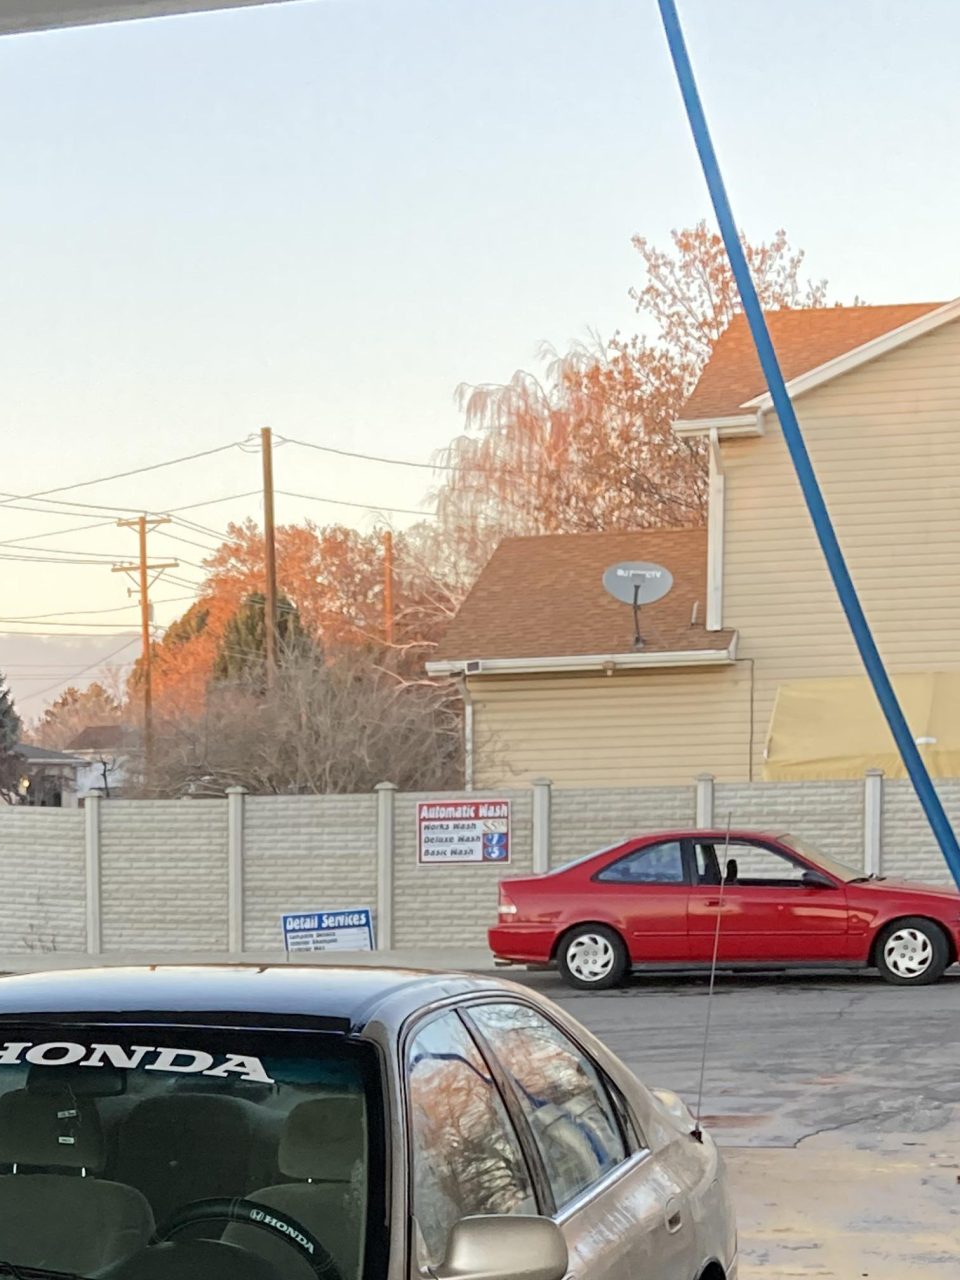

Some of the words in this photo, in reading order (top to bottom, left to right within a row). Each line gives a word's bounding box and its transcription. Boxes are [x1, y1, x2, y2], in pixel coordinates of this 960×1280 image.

[420, 805, 476, 819] Automatic
[479, 803, 508, 818] Wash
[453, 822, 477, 830] Wash
[423, 836, 455, 844] Deluxe
[457, 835, 481, 843] Wash
[423, 849, 448, 857] Basic
[450, 848, 474, 856] Wash
[286, 915, 318, 930] Detail
[321, 913, 367, 928] Services
[264, 1215, 314, 1254] HONDA
